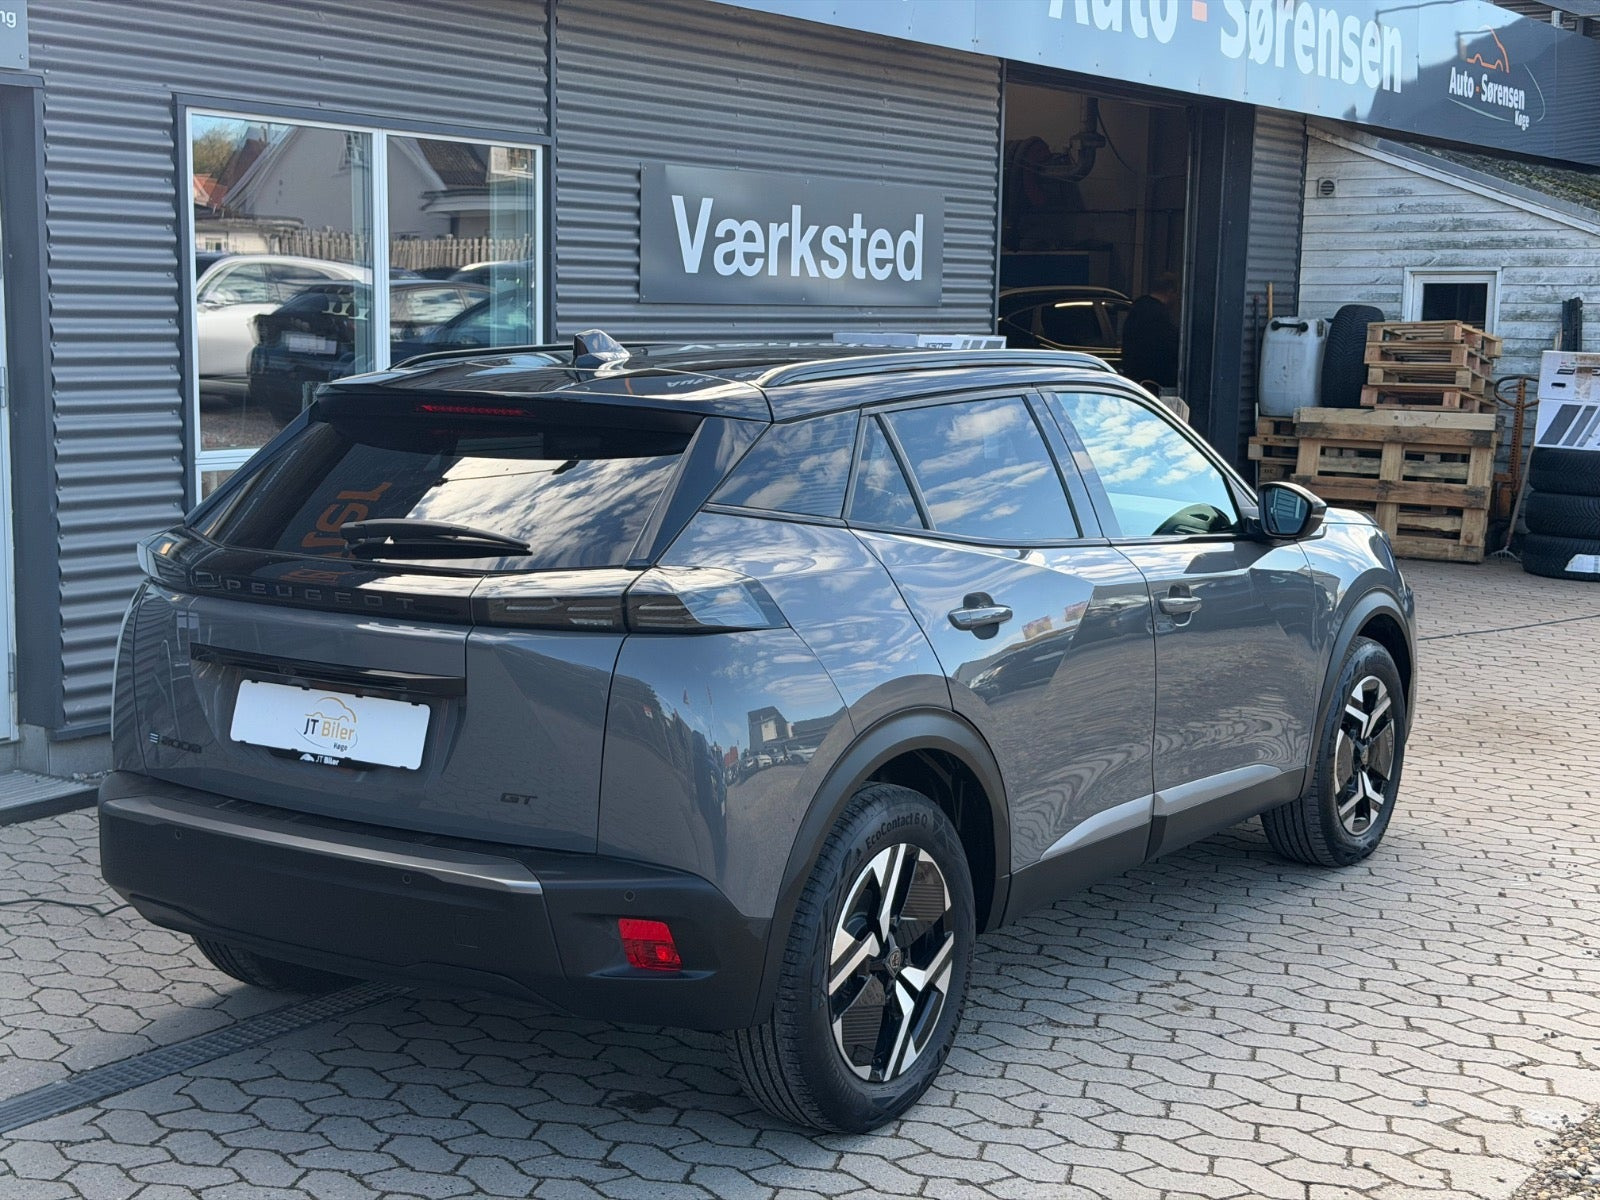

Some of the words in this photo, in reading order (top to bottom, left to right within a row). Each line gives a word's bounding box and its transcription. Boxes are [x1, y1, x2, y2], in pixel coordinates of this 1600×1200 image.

[1220, 0, 1402, 93] Sørensen
[1449, 66, 1475, 98] Auto
[1480, 73, 1525, 110] Sørensen
[671, 194, 924, 281] Værksted
[226, 579, 414, 609] PEUGEOT
[303, 718, 320, 735] JT
[322, 721, 355, 741] Biler
[500, 792, 538, 805] GT
[865, 812, 913, 850] EcoContact
[914, 812, 921, 825] 6
[921, 813, 928, 829] Q
